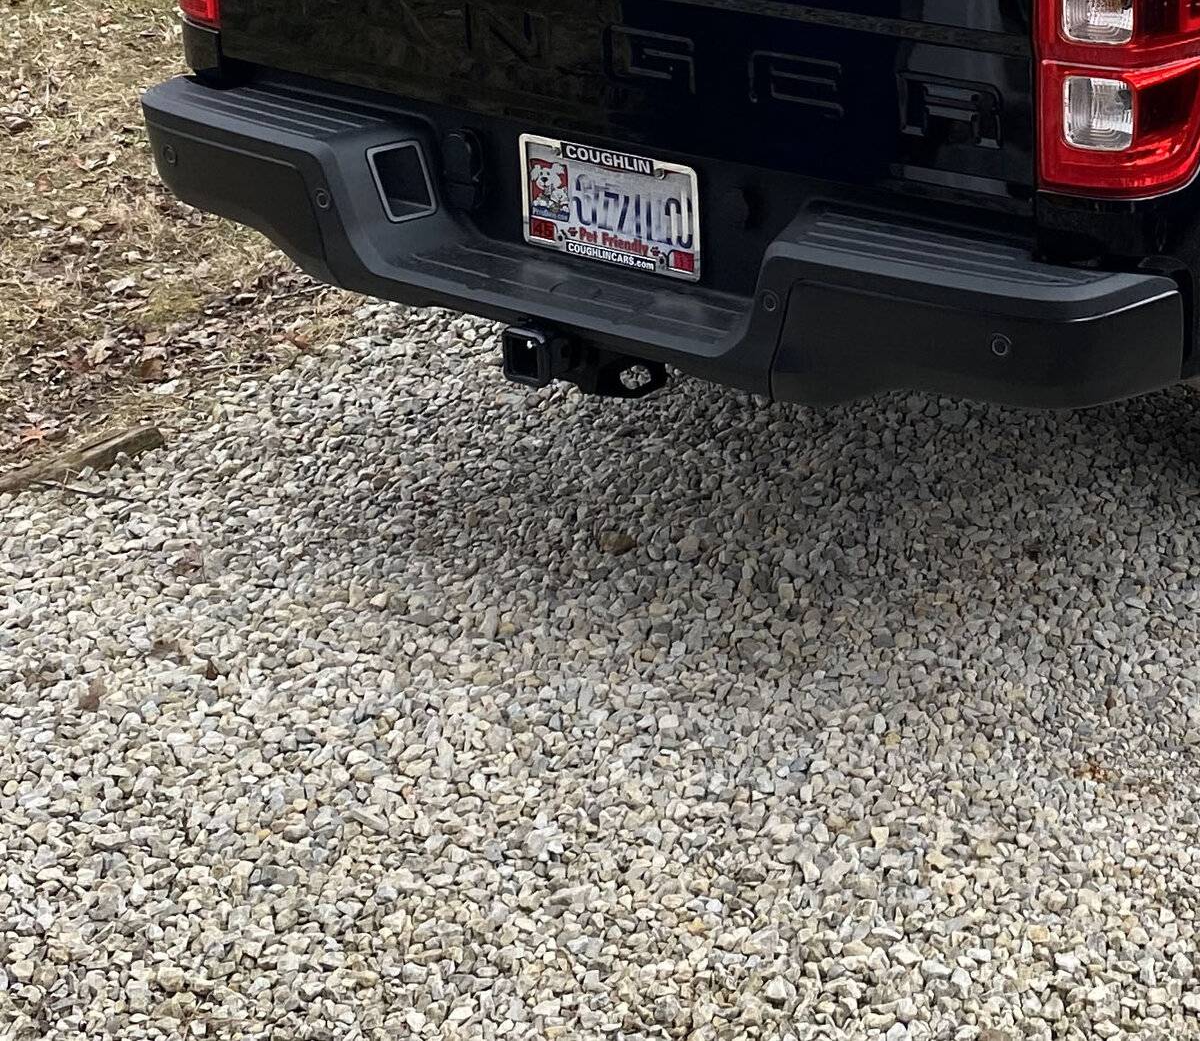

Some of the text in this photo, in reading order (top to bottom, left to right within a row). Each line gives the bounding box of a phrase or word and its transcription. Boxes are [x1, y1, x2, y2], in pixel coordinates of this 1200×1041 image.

[565, 144, 651, 174] COUGHLIN
[578, 226, 650, 256] Pet Friendly
[567, 243, 655, 271] COUGHLINCARS.com
